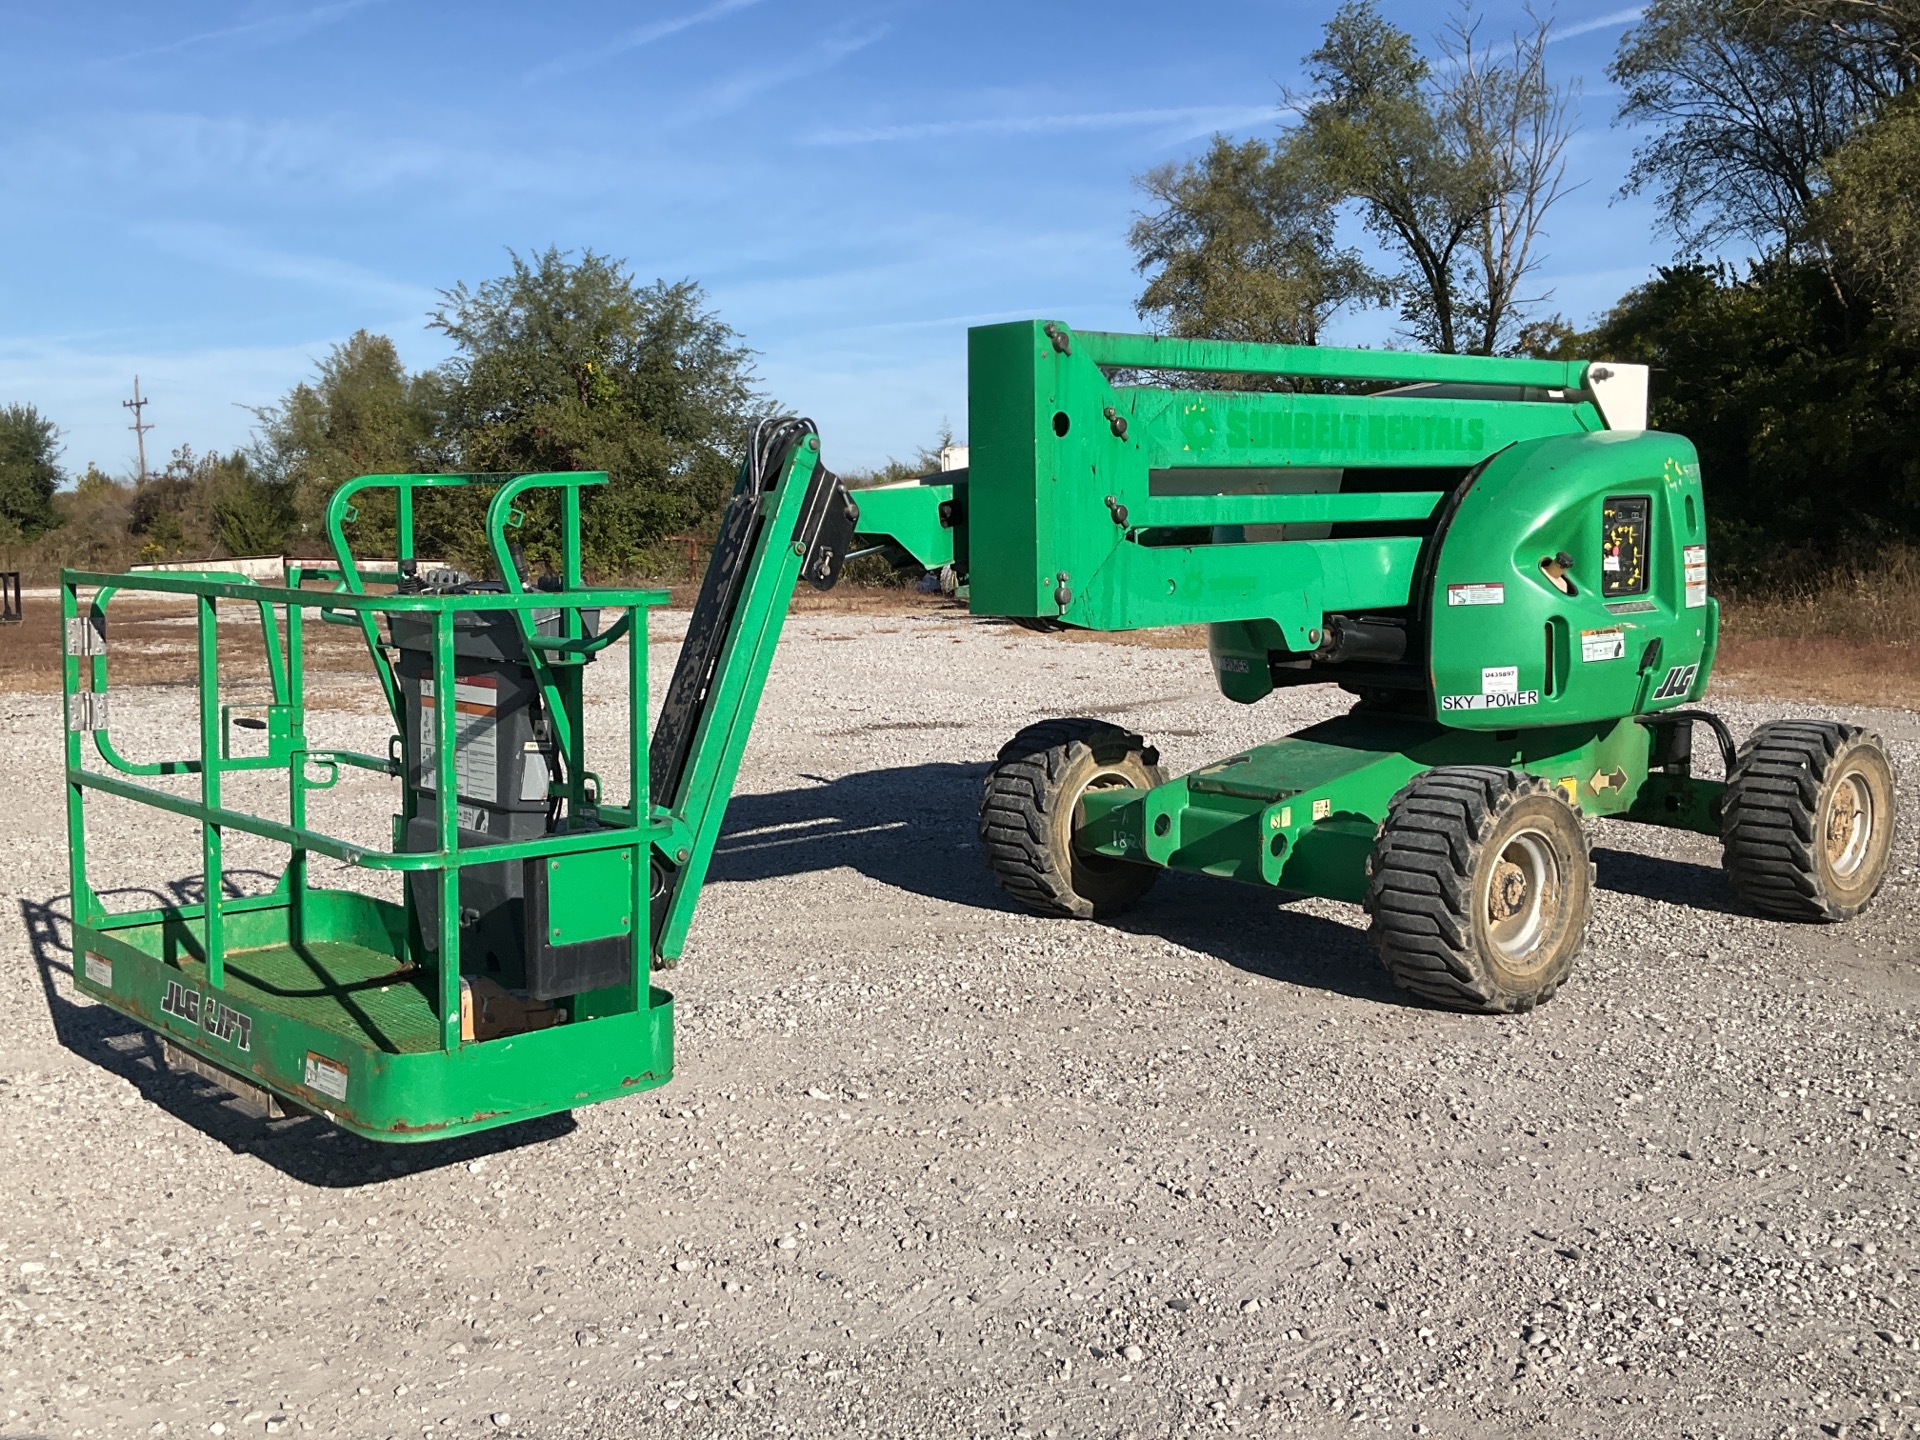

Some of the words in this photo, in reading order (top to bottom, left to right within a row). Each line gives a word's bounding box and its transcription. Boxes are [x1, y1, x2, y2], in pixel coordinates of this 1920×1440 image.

[1226, 410, 1361, 449] SUNBELT
[1367, 414, 1485, 450] RENTALS
[1443, 695, 1474, 710] SKY
[1486, 691, 1537, 707] POWER
[1651, 663, 1698, 700] JLG
[161, 980, 200, 1025] JLG
[203, 997, 252, 1051] LIFT
